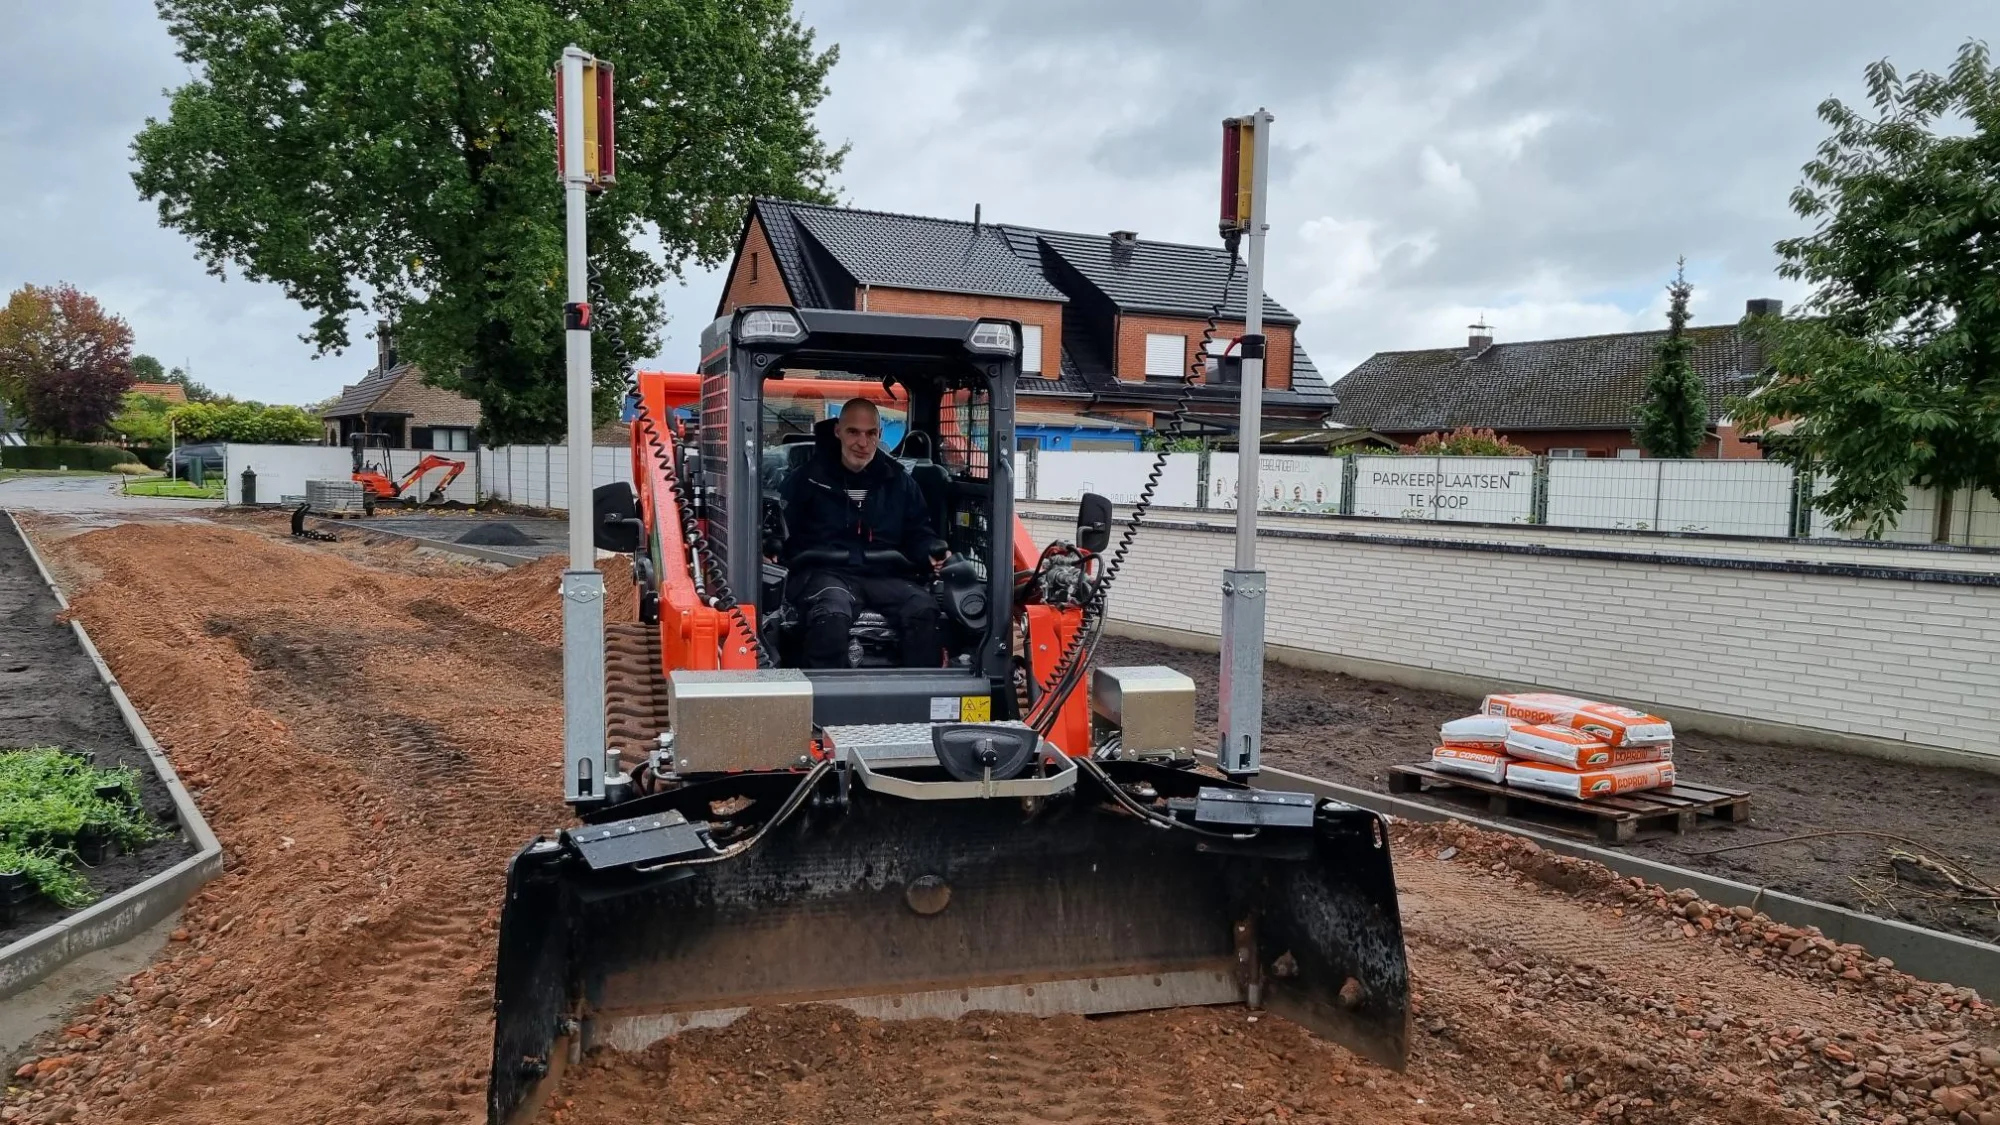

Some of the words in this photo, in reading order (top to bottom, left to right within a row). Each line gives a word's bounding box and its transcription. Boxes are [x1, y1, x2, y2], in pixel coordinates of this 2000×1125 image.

[1373, 472, 1511, 489] PARKEERPLAATSEN
[1408, 494, 1424, 507] TE
[1428, 495, 1468, 509] KOOP
[1510, 707, 1554, 724] COPRON
[1459, 751, 1496, 762] COPRON
[1617, 775, 1648, 789] COPRON
